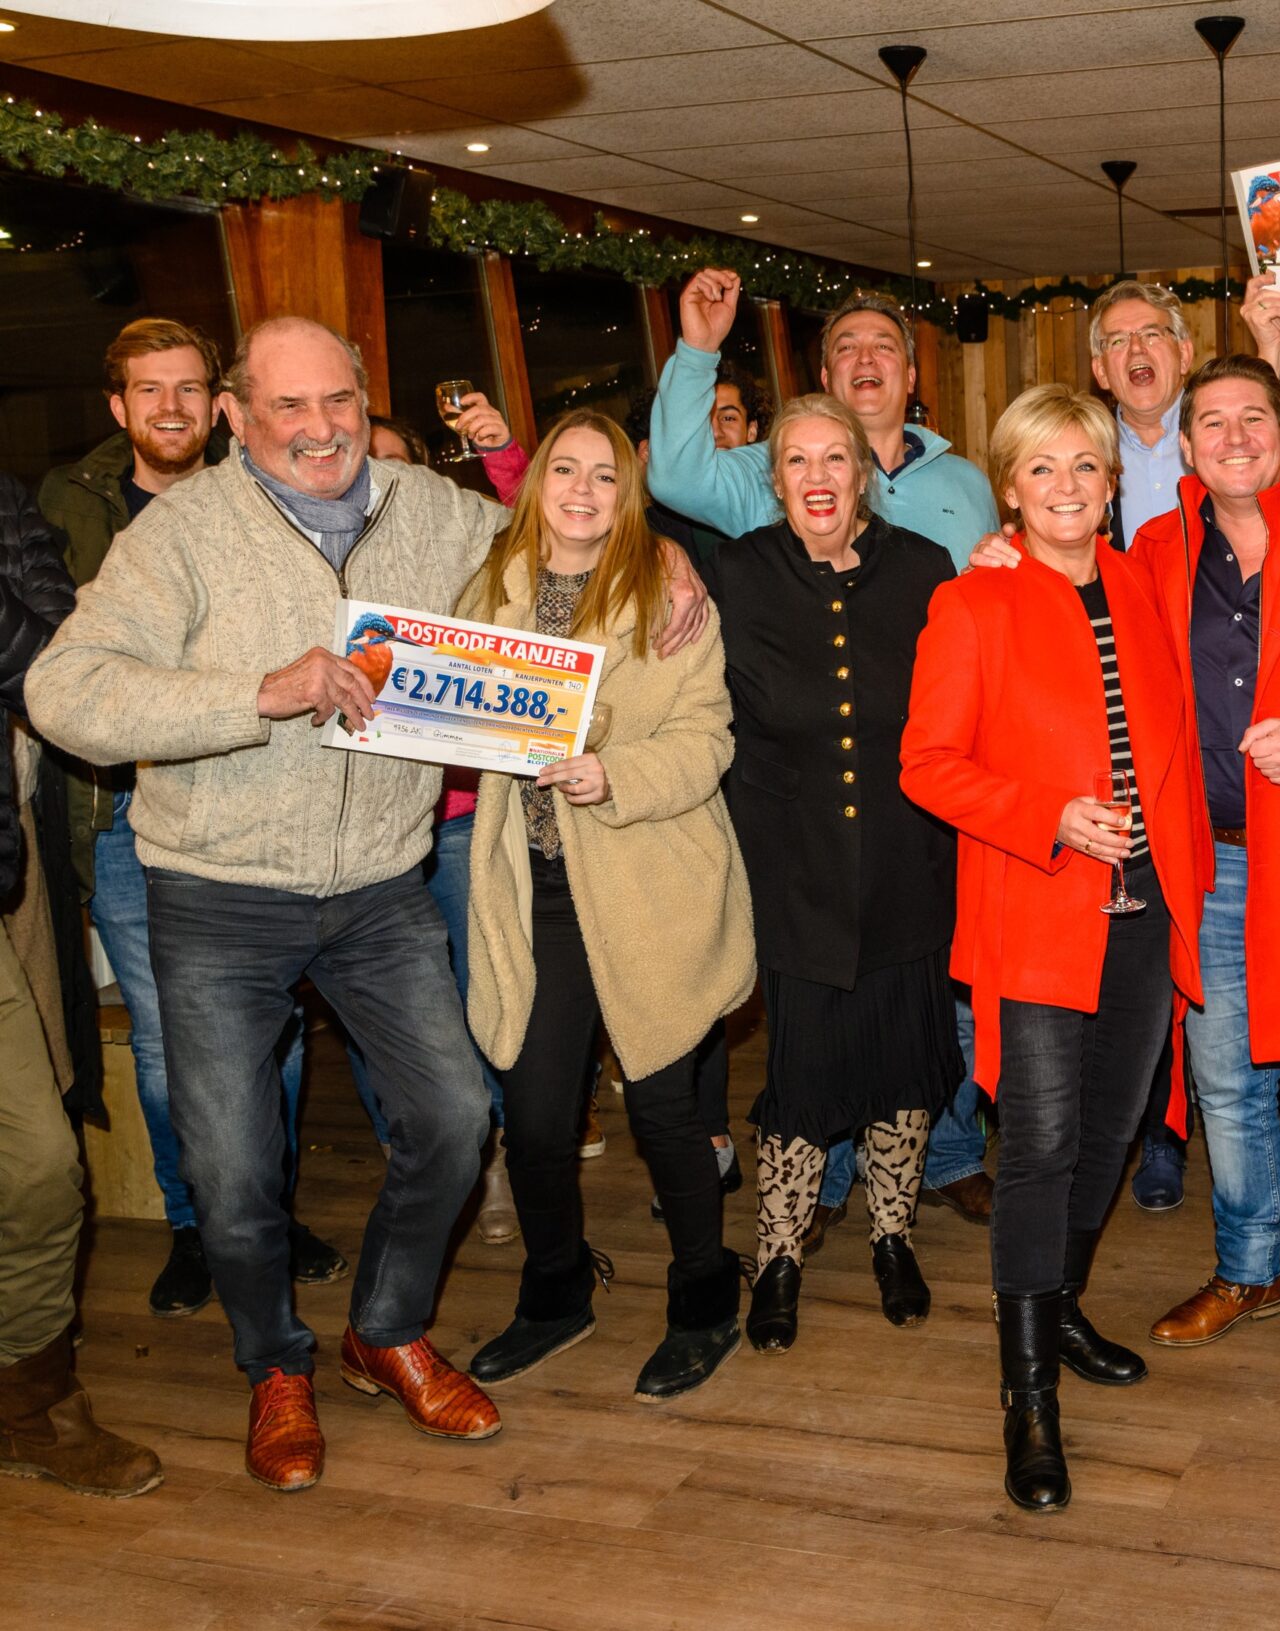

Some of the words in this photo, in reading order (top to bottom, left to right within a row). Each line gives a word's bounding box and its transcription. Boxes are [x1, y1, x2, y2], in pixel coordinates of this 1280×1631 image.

[396, 619, 495, 651] POSTCODE
[500, 634, 579, 670] KANJER
[448, 661, 471, 672] AANTAL
[473, 665, 493, 675] LOTEN
[515, 672, 564, 687] KANJERPUNTEN
